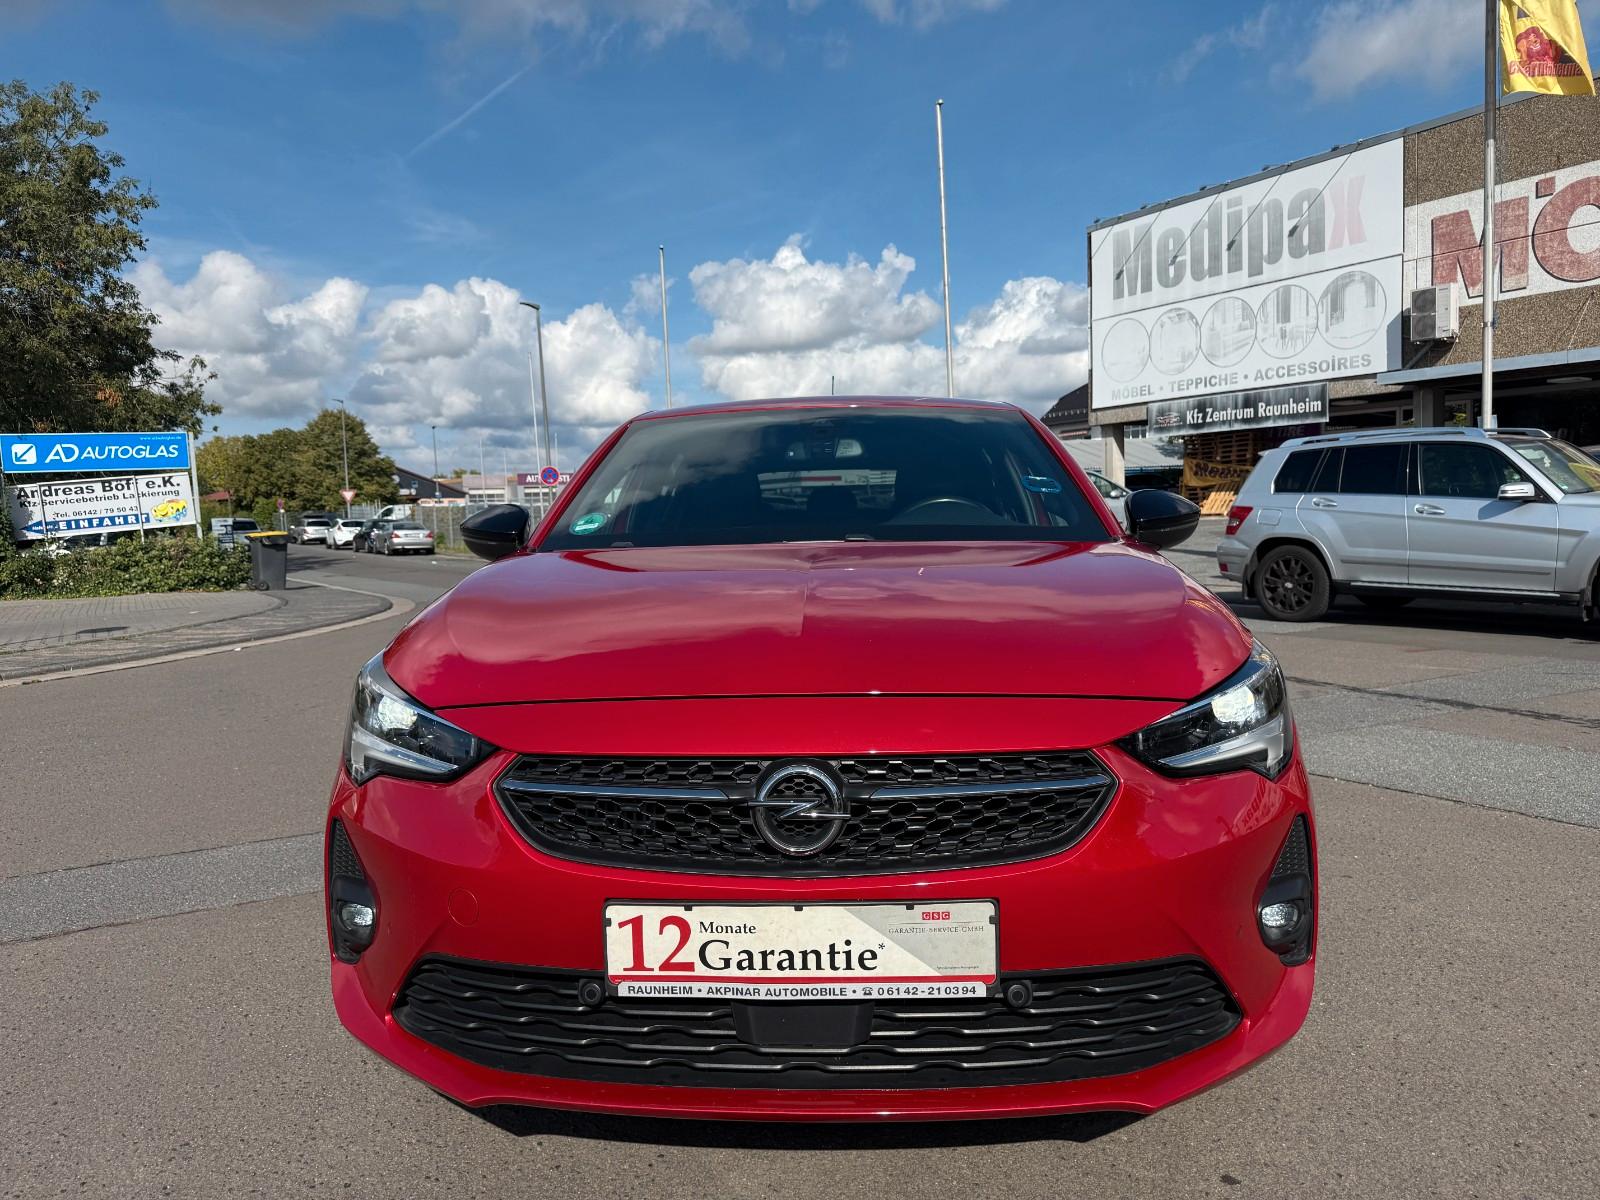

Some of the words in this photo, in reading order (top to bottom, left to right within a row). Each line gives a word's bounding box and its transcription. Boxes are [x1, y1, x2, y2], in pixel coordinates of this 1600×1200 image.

[1112, 175, 1367, 300] Medipax
[1111, 385, 1155, 400] MÖBEL
[1168, 372, 1238, 393] TEPPICHE
[1187, 409, 1203, 424] Kfz
[1206, 407, 1254, 422] Zentrum
[1258, 399, 1322, 418] Raunheim
[45, 443, 79, 463] AD
[81, 444, 178, 459] AUTOGLAS
[17, 484, 95, 500] Andreas
[146, 476, 181, 489] e.K.
[58, 514, 148, 530] EINFAHRT
[73, 509, 97, 517] 06142
[104, 507, 114, 515] 79
[117, 506, 127, 514] 50
[699, 922, 756, 934] Monate
[922, 912, 950, 920] GSG
[617, 914, 695, 972] 12
[628, 986, 693, 995] RAUNHEIM
[706, 987, 761, 996] AKPINAR
[764, 987, 847, 997] AUTOMOBILE
[877, 985, 977, 996] 06142-210394
